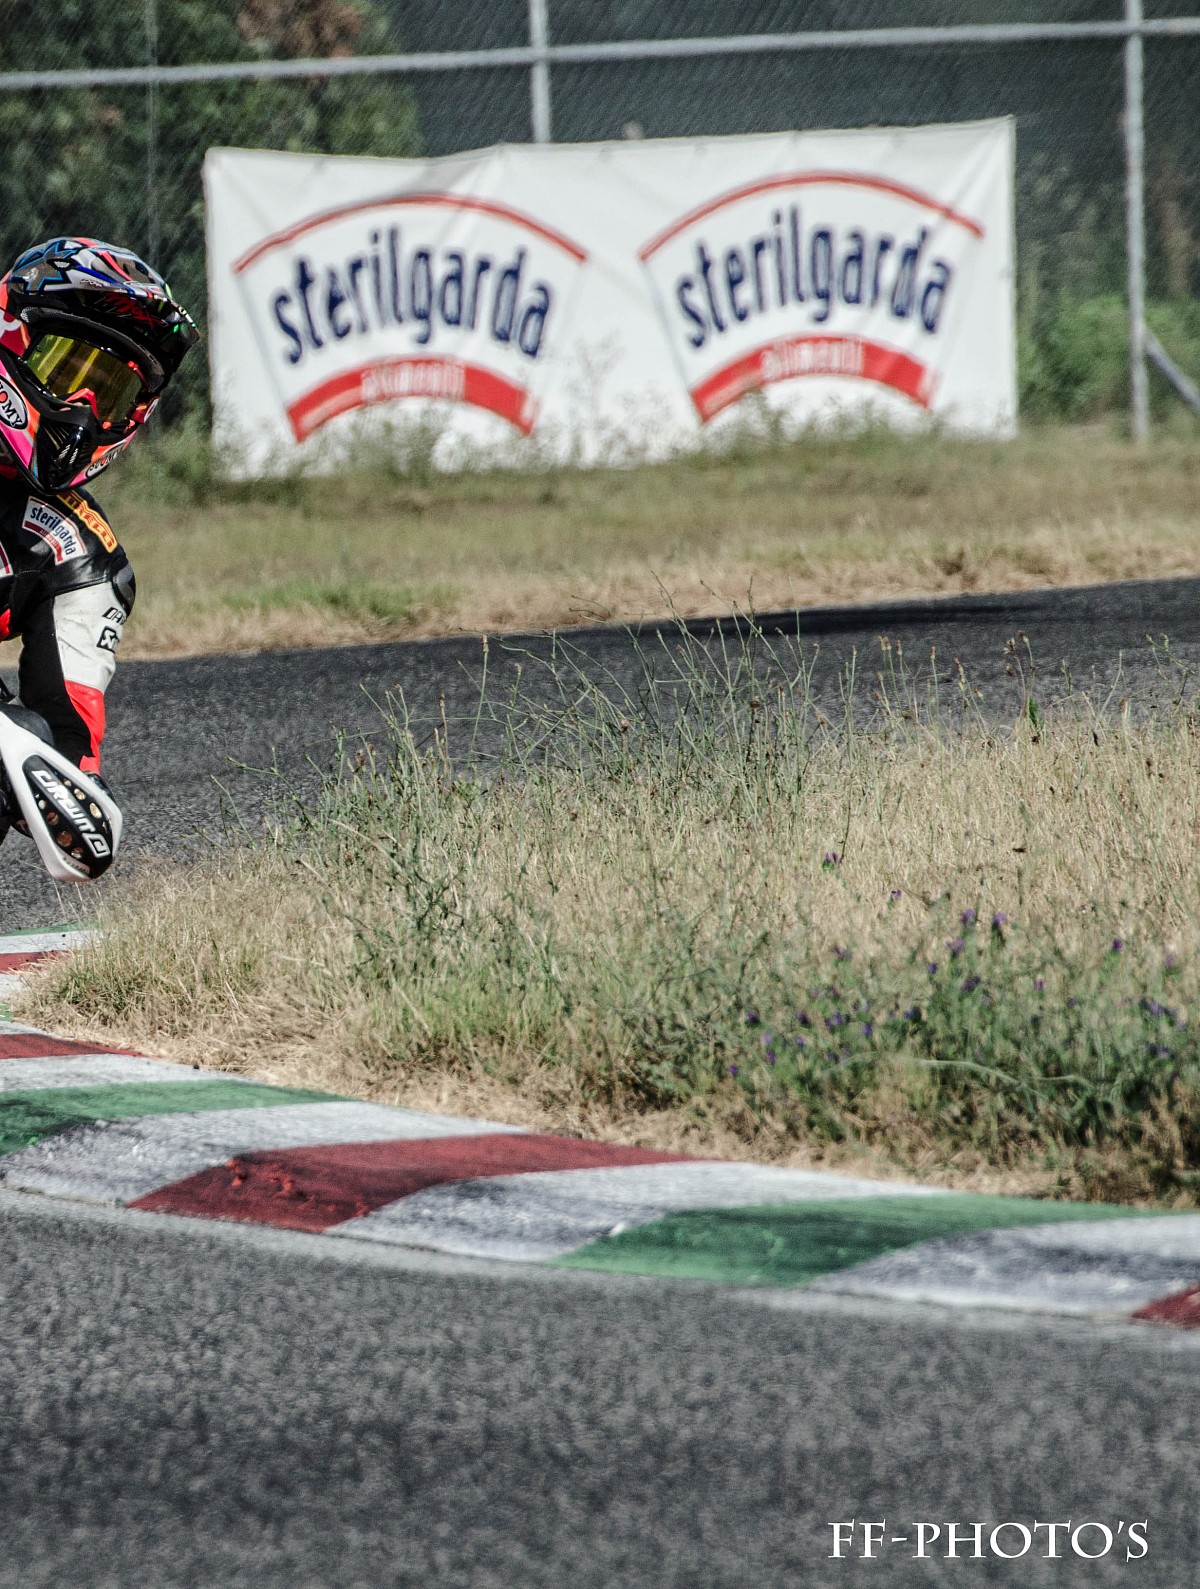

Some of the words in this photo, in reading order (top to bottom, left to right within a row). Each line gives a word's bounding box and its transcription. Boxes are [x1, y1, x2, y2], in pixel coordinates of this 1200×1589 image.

[272, 226, 552, 364] sterilgarda
[676, 203, 952, 348] sterilgarda
[30, 506, 77, 555] sterilgarda
[31, 770, 96, 832] CIRCUIT
